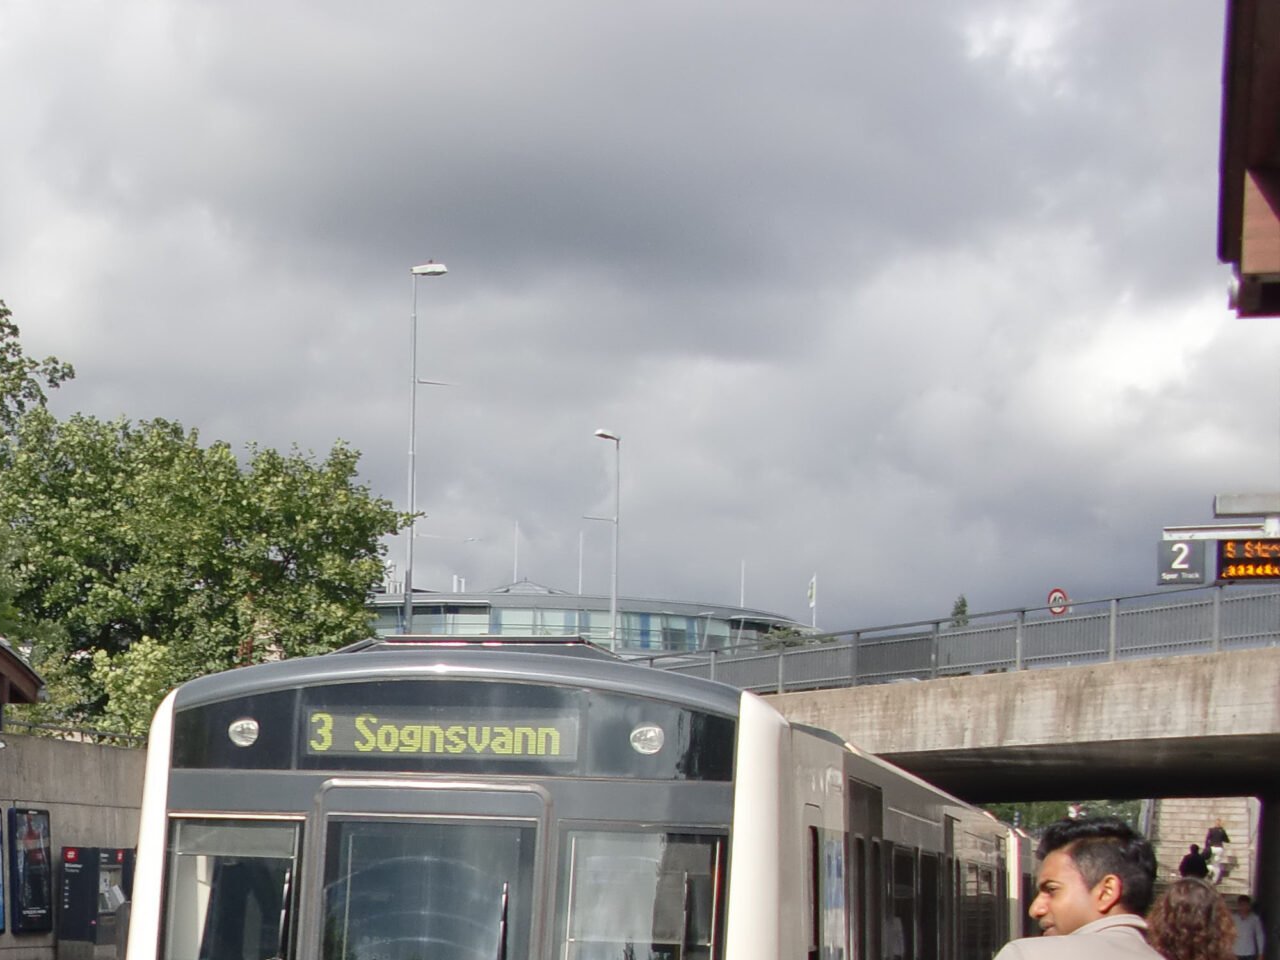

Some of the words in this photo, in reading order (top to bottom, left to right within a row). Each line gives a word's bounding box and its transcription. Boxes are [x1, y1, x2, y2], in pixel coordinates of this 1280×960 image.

[1171, 543, 1189, 569] 2
[310, 713, 333, 751] 3
[354, 714, 560, 755] Sognsvann
